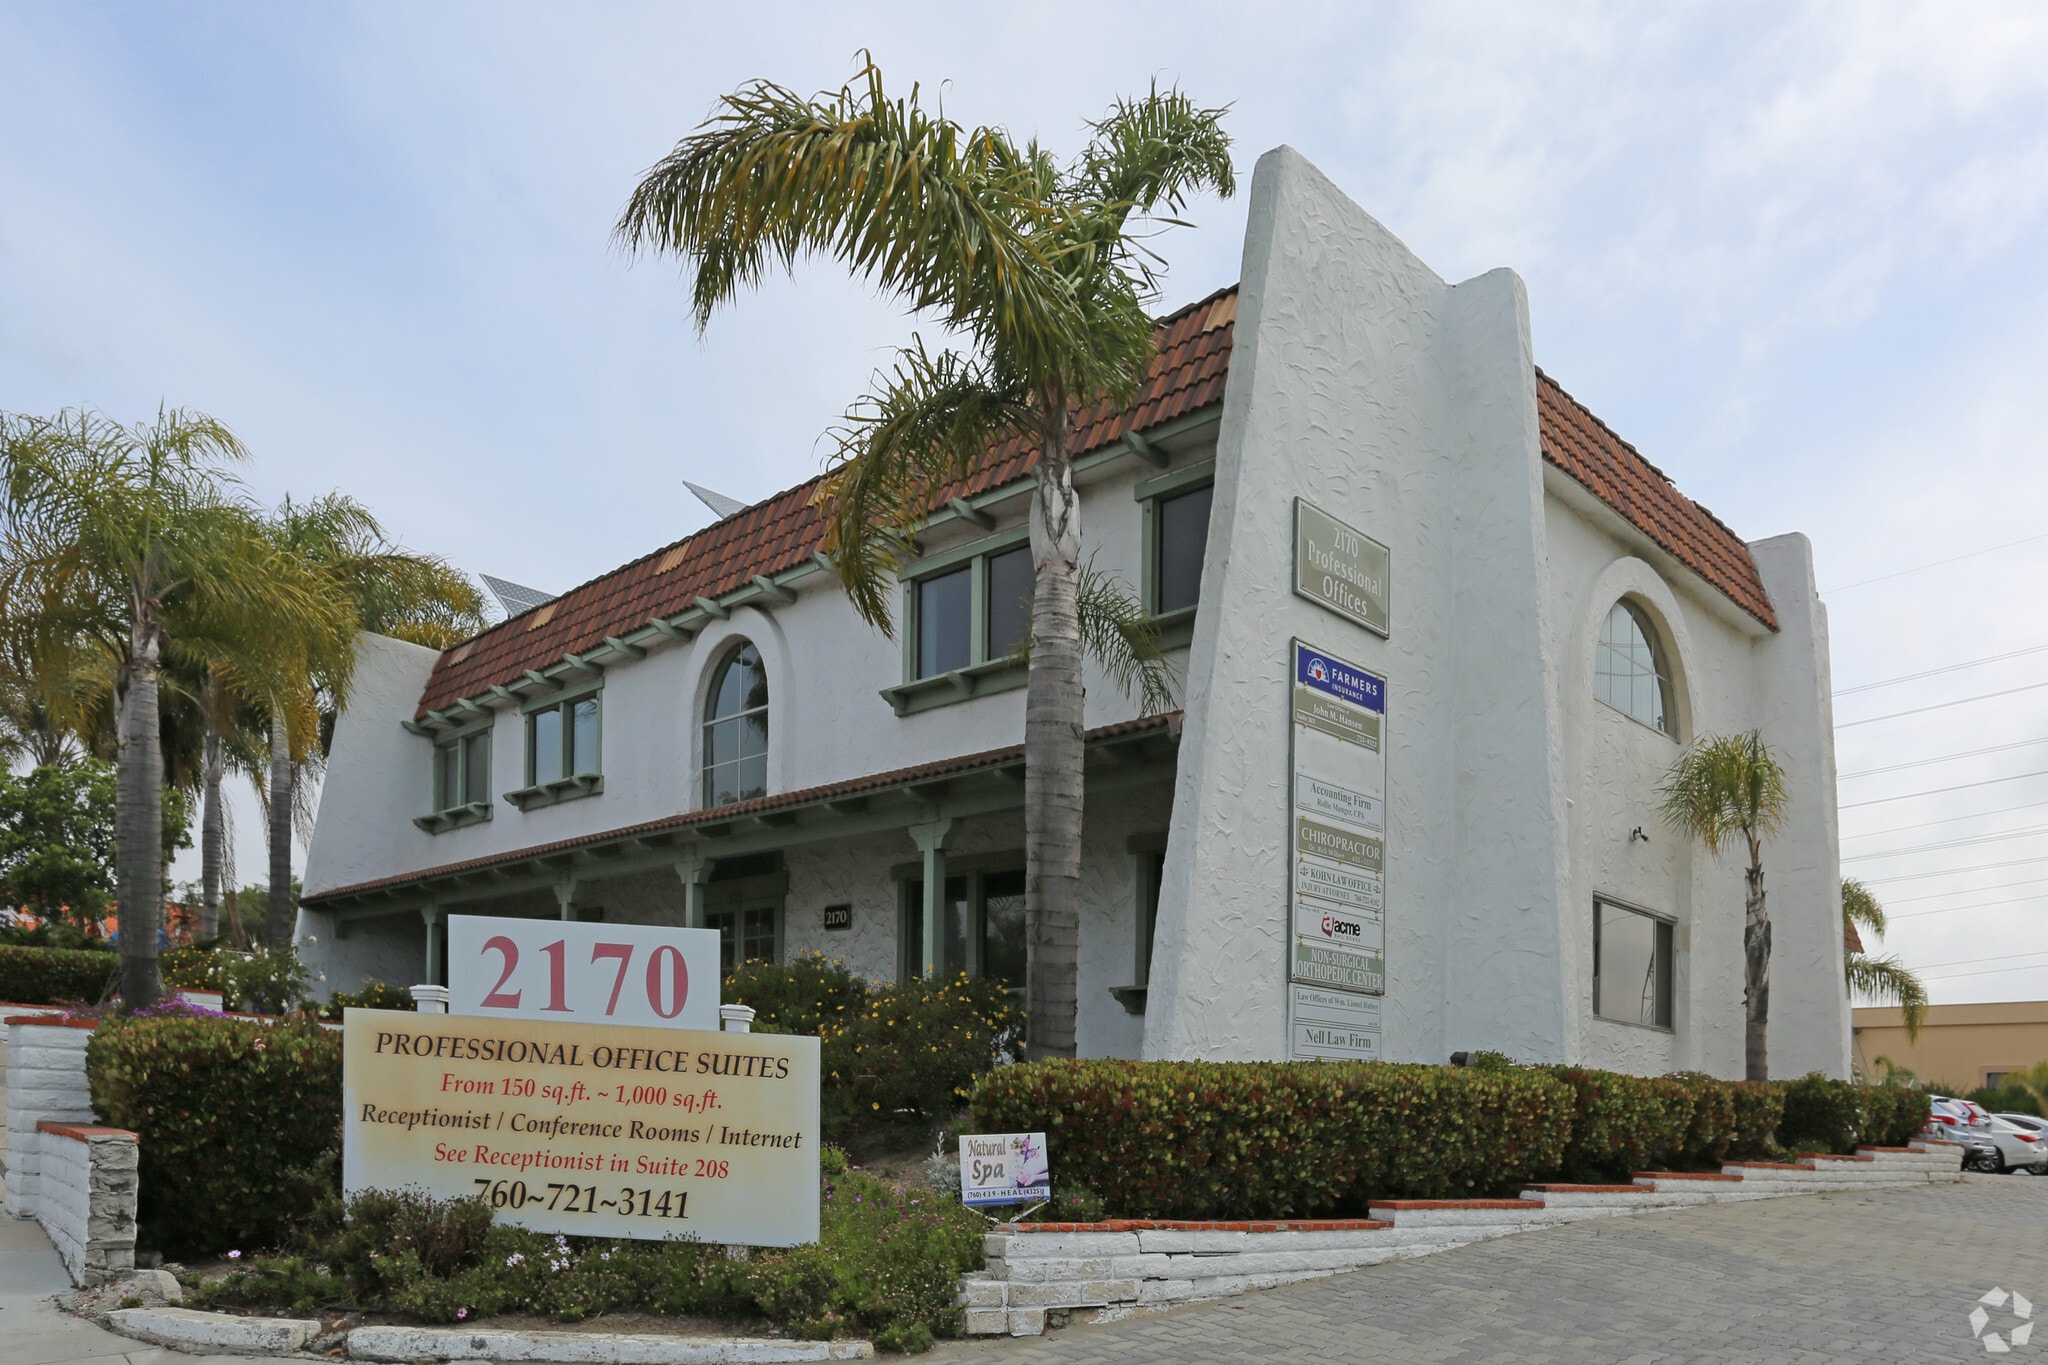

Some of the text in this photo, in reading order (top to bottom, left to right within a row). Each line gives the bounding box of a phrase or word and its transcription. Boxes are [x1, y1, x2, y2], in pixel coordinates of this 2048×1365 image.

[1334, 527, 1358, 558] 2170
[1308, 539, 1382, 598] Professional
[1322, 575, 1367, 616] Offices
[1331, 683, 1363, 701] INSURANCE
[1332, 668, 1377, 696] FARMERS
[1313, 704, 1362, 730] John M. Hansen
[1311, 782, 1371, 810] Accounting Firm
[1353, 809, 1365, 820] CPA
[1301, 827, 1380, 860] CHIROPRACTOR
[1301, 881, 1321, 893] INJURY
[1322, 887, 1350, 900] ATTORNEY
[1311, 868, 1372, 892] KOHN LAW OFFICE
[825, 910, 847, 925] 2170
[1334, 920, 1361, 936] acme
[1311, 948, 1370, 971] NON-SURGICAL
[480, 935, 689, 1019] 2170
[1297, 960, 1383, 989] ORTHOPEDIC CENTER
[1297, 992, 1308, 1001] Law
[1306, 1029, 1371, 1048] Nell Law Firm
[374, 1032, 789, 1079] PROFESSIONAL OFFICE SUITES
[441, 1073, 494, 1095] From
[501, 1078, 536, 1097] 150
[541, 1081, 590, 1106] sq.ft.
[616, 1085, 667, 1106] 1,000
[673, 1089, 722, 1114] sq.ft.
[360, 1103, 492, 1131] Receptionist
[511, 1113, 622, 1140] Conference
[628, 1120, 700, 1143] Rooms
[719, 1126, 802, 1149] Internet
[434, 1142, 729, 1179] See Receptionist in Suite 208
[967, 1137, 1007, 1157] Natural
[972, 1159, 1005, 1186] Spa
[968, 1191, 981, 1199] (760)
